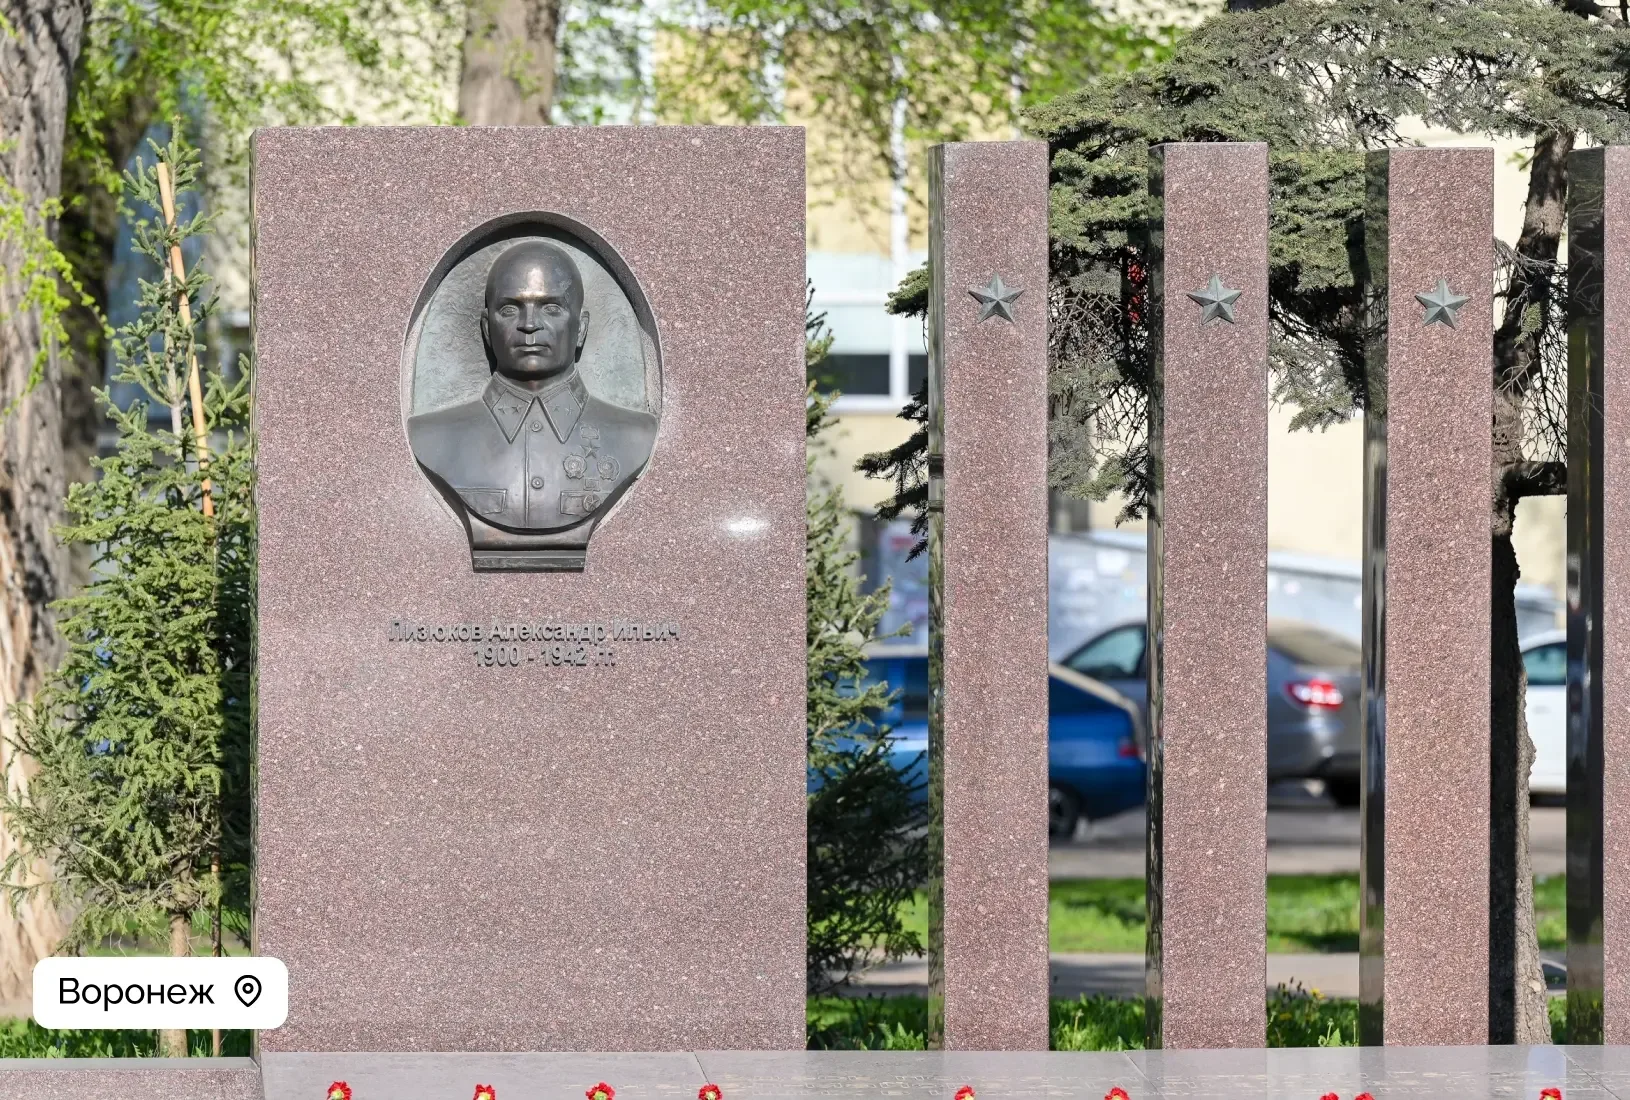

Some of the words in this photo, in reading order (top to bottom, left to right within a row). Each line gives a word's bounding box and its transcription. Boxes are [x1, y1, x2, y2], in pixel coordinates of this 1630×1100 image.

[389, 620, 483, 642] Лизюков
[488, 620, 606, 645] Александр
[613, 619, 681, 642] Ильич
[474, 646, 521, 667] 1900
[542, 646, 587, 667] 1942
